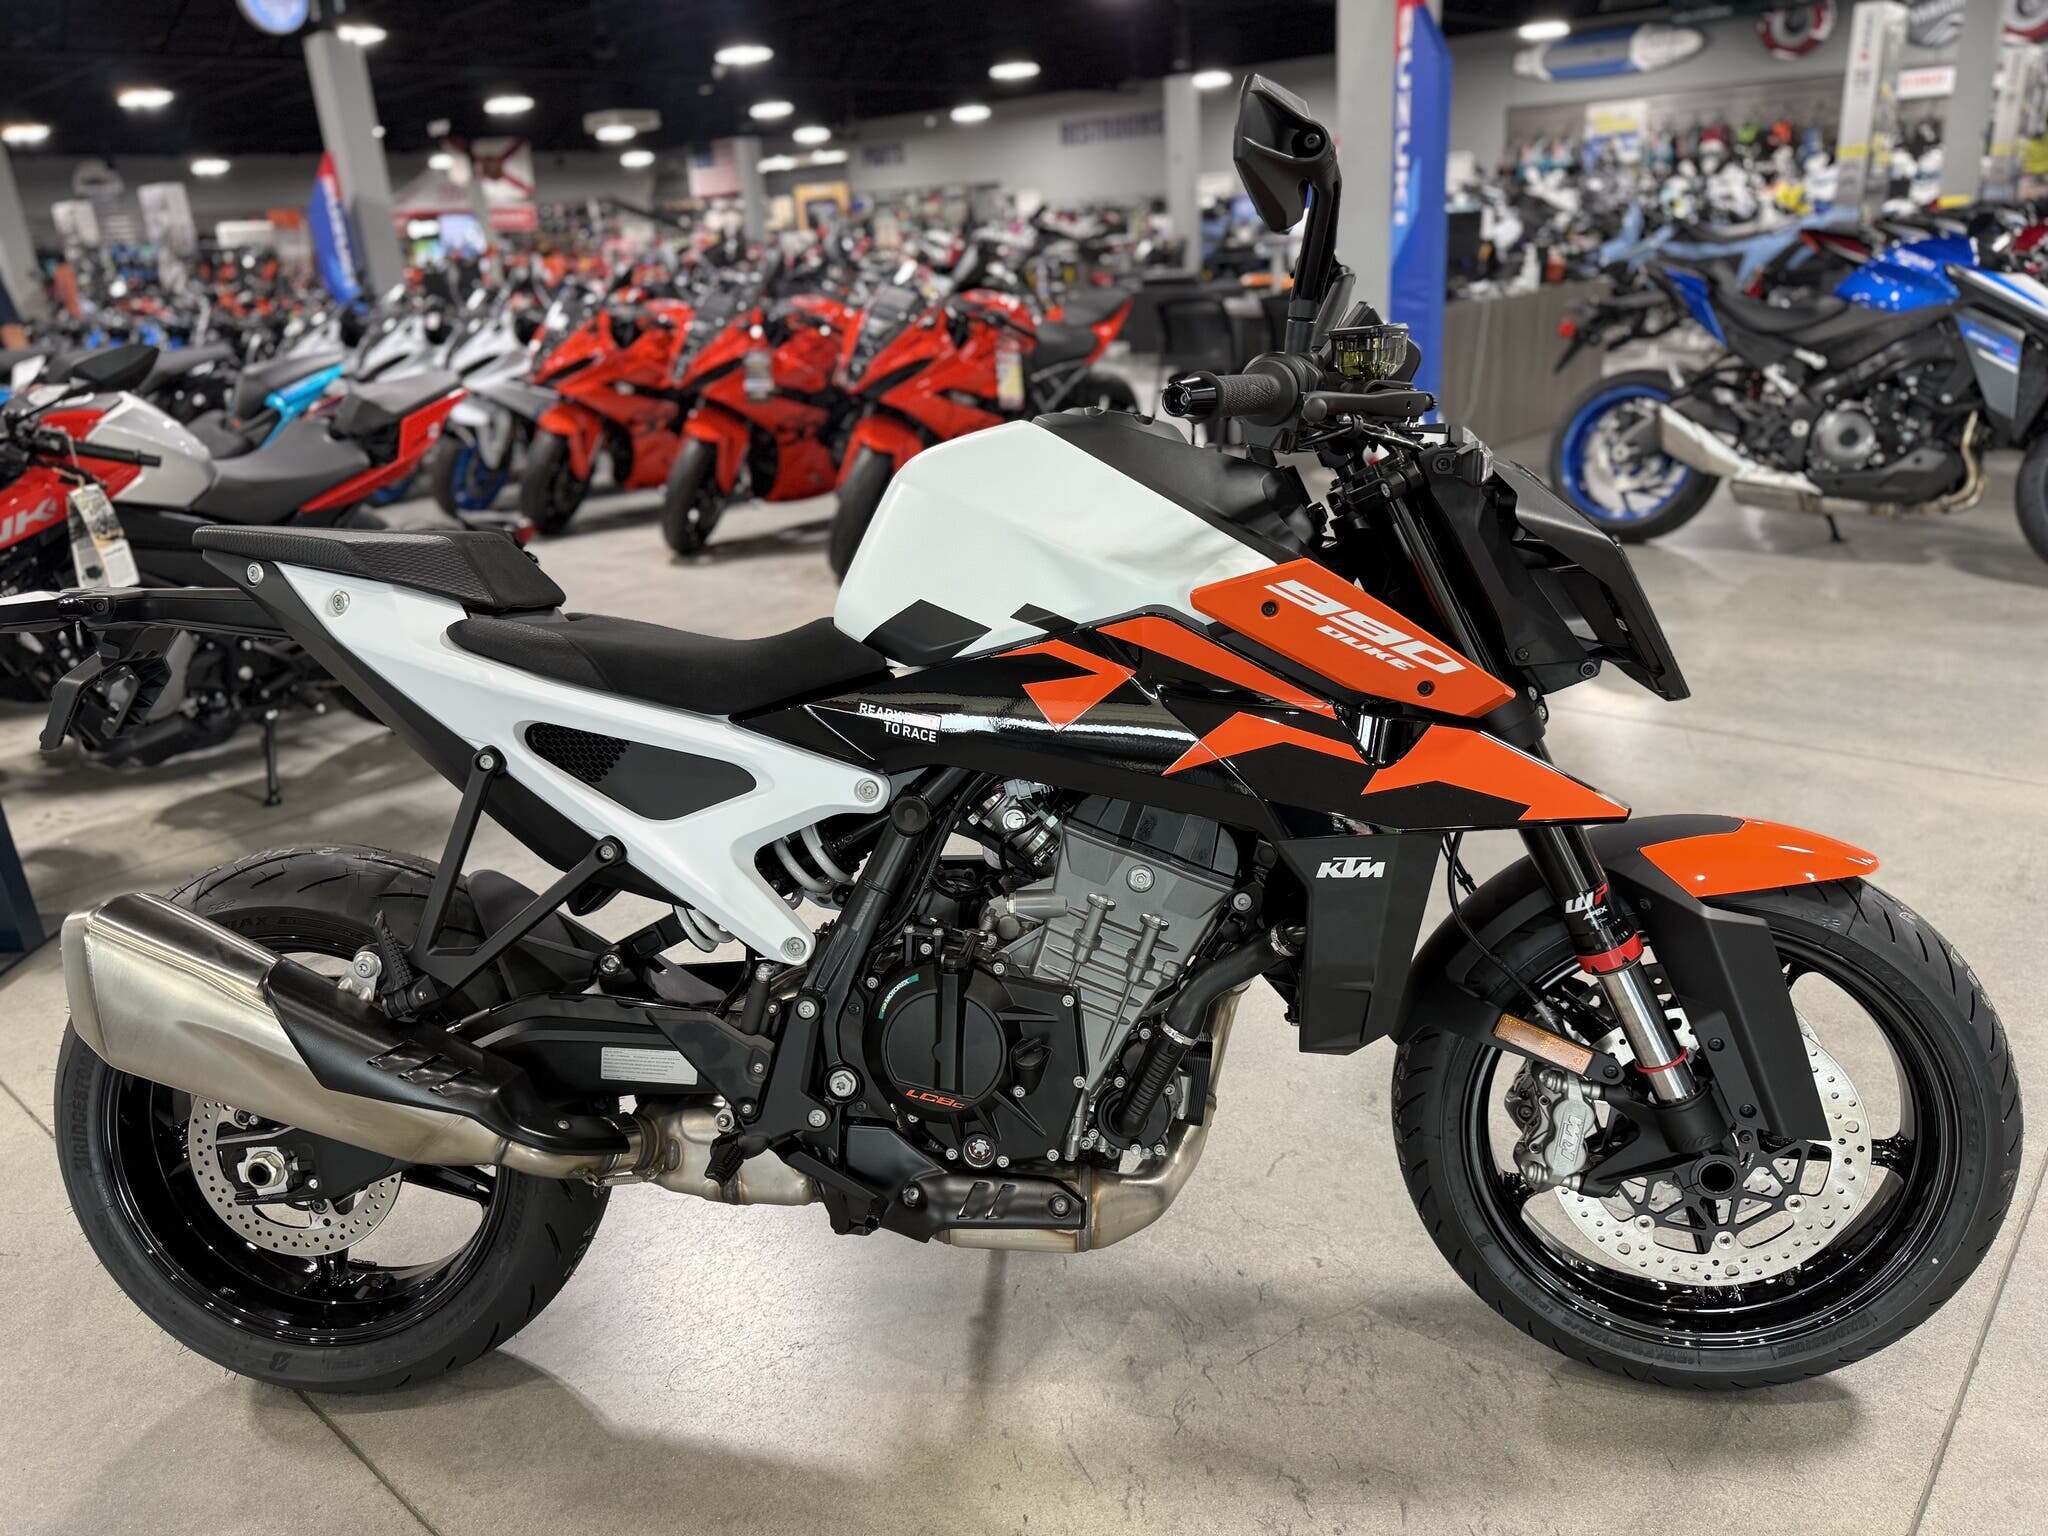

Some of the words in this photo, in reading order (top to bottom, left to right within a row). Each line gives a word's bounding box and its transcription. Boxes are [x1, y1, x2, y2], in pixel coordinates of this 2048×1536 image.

[1263, 579, 1467, 674] 990
[1316, 625, 1417, 670] DUKE
[884, 721, 900, 735] TO
[902, 725, 937, 743] RACE
[1316, 856, 1386, 878] KTM
[1560, 1115, 1584, 1161] KTM
